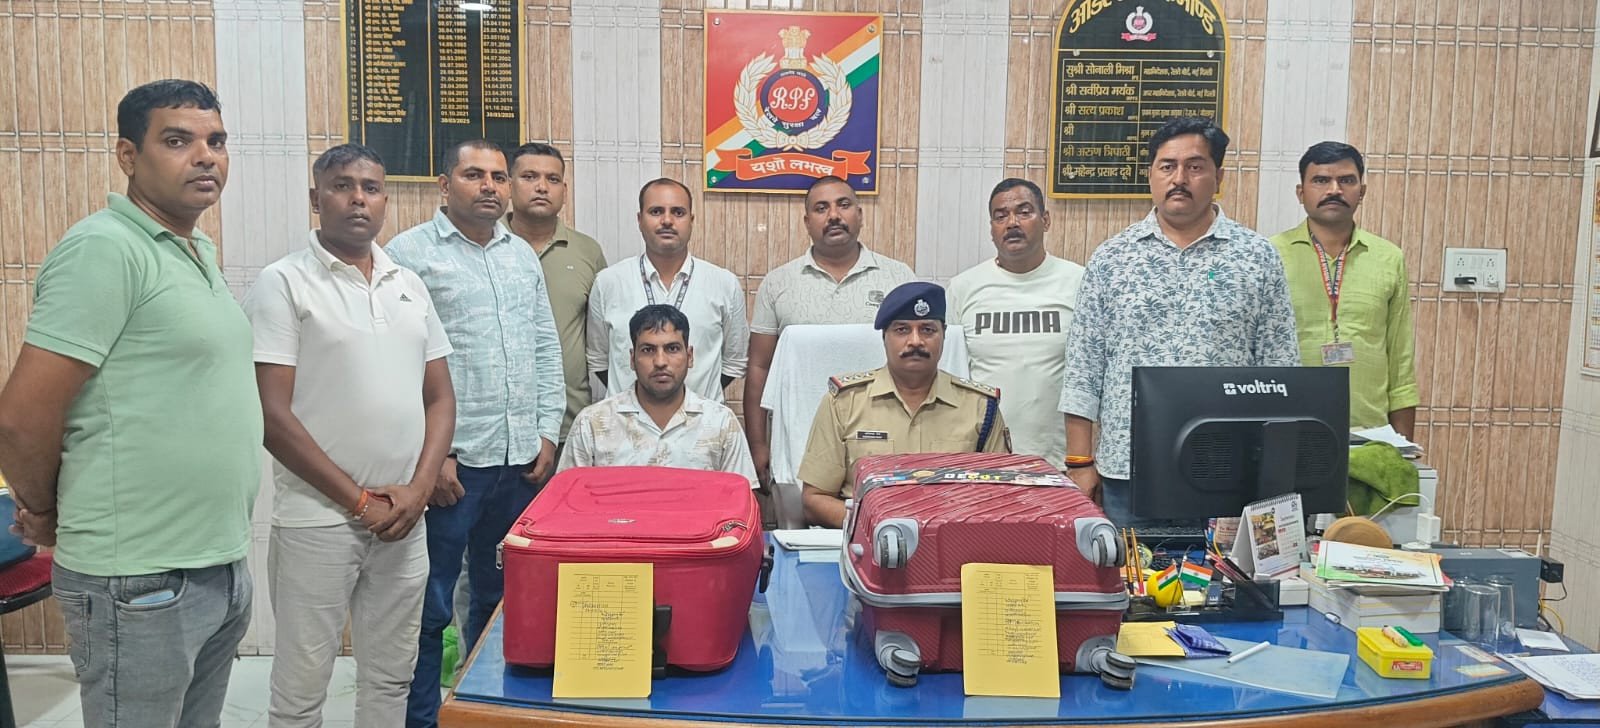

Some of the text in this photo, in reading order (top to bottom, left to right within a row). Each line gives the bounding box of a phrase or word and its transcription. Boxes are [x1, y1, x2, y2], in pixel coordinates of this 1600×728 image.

[1066, 62, 1135, 78] सुश्री सोनाली मिश्रा
[1066, 84, 1077, 96] श्री
[1111, 83, 1135, 96] मयंक
[770, 86, 815, 110] RPF
[1065, 103, 1124, 115] श्री सत्य प्रकाश
[1064, 123, 1074, 135] श्री
[1064, 144, 1074, 156] श्री
[1077, 148, 1101, 156] अरुण
[1104, 145, 1130, 156] त्रिपाठी
[1062, 164, 1072, 176] श्री
[975, 310, 1061, 334] PUMA
[1236, 379, 1288, 396] voltriq
